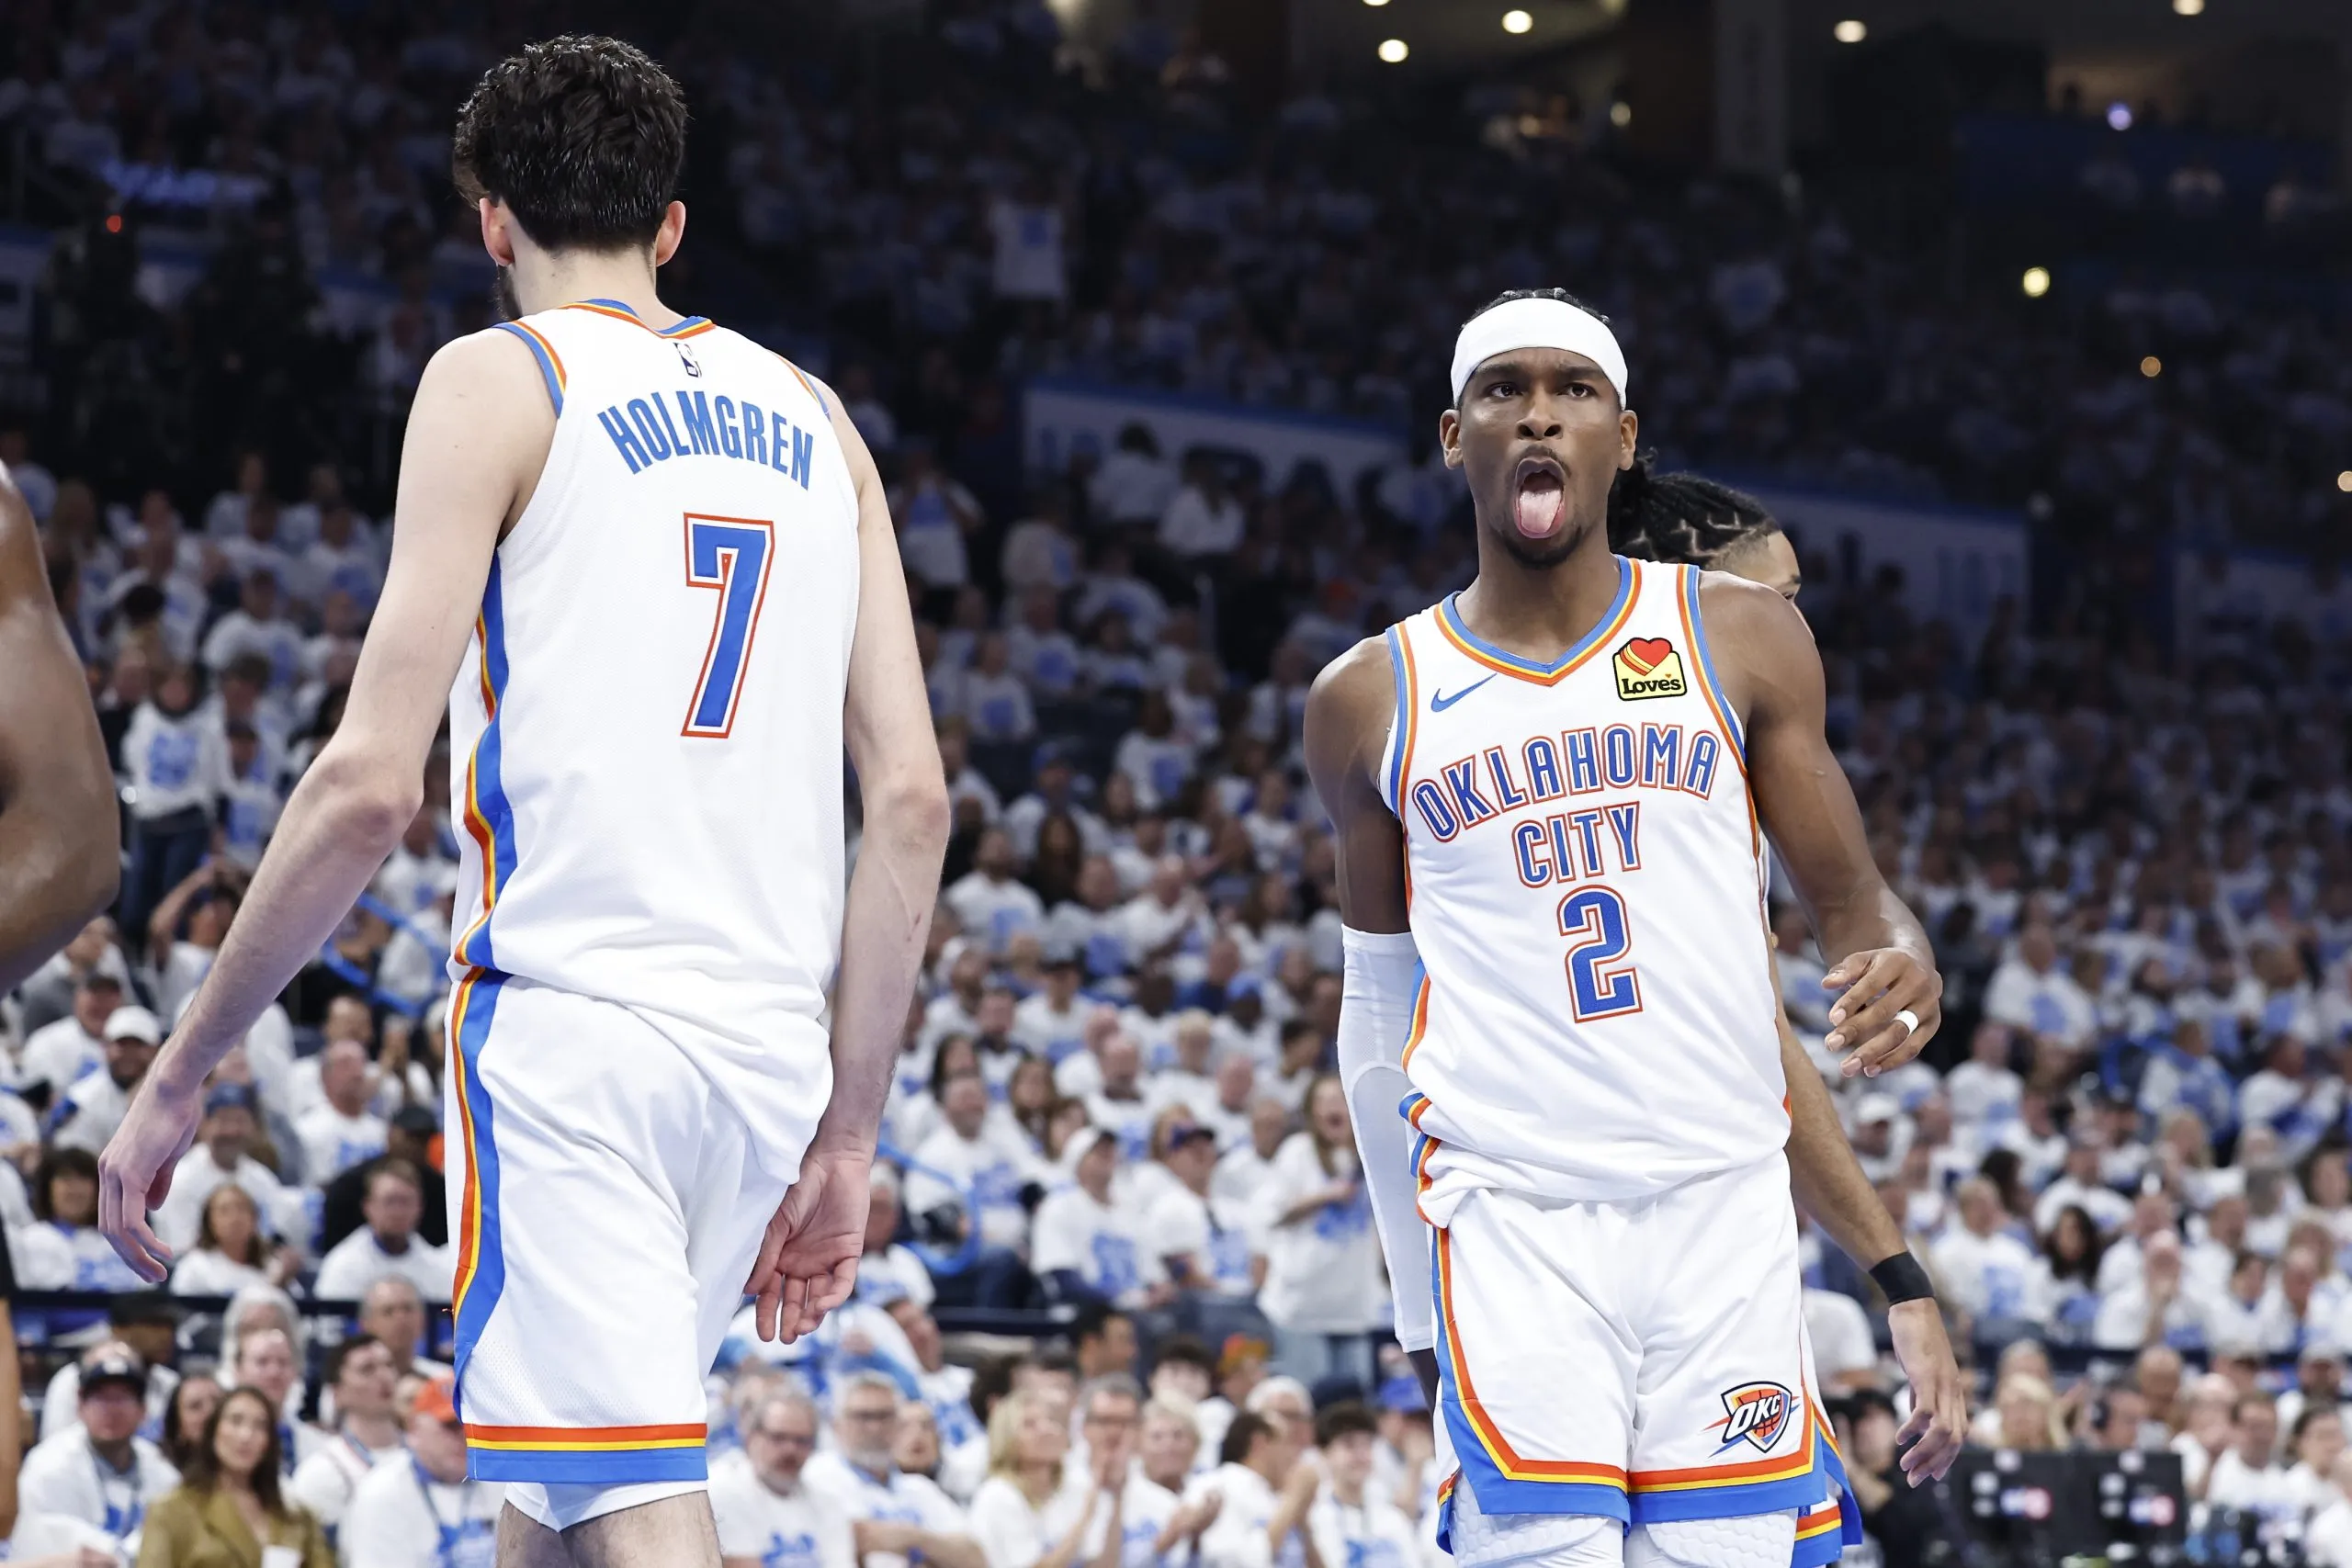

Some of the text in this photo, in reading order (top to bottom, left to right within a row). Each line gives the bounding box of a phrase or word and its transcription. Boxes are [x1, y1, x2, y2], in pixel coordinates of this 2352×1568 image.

[597, 390, 814, 491] HOLMGREN
[681, 512, 775, 739] 7
[1412, 722, 1721, 843] OKLAHOMA
[1511, 801, 1641, 888] CITY
[1556, 885, 1644, 1023] 2
[1722, 1393, 1781, 1443] OKC
